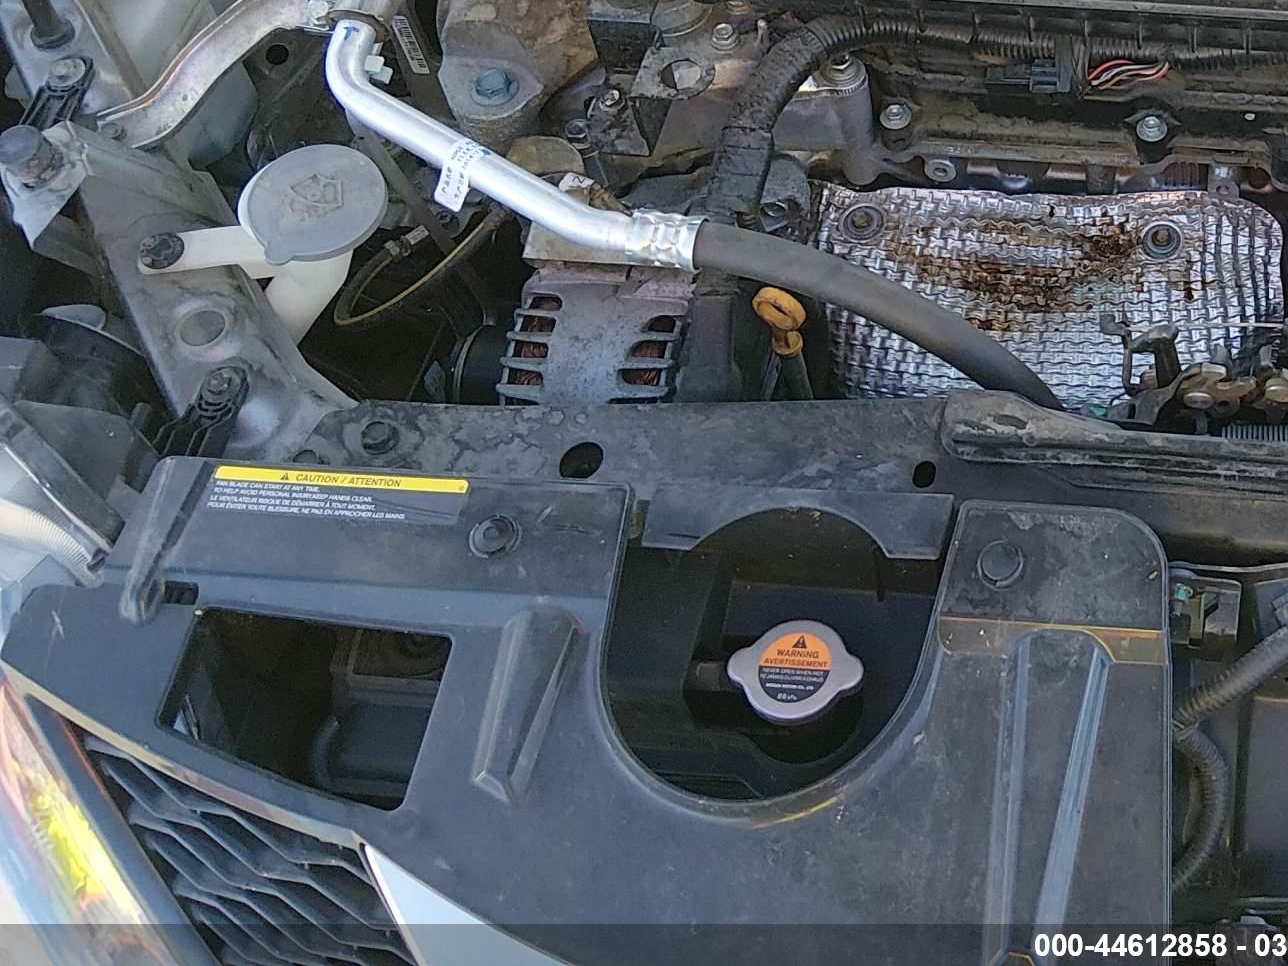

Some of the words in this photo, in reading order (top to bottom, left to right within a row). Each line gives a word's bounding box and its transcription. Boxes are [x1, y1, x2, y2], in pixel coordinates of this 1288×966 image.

[295, 474, 338, 483] CAUTION
[348, 477, 401, 487] ATTENTION
[777, 649, 819, 658] WARNING
[764, 658, 828, 667] AVERTISSEMENT
